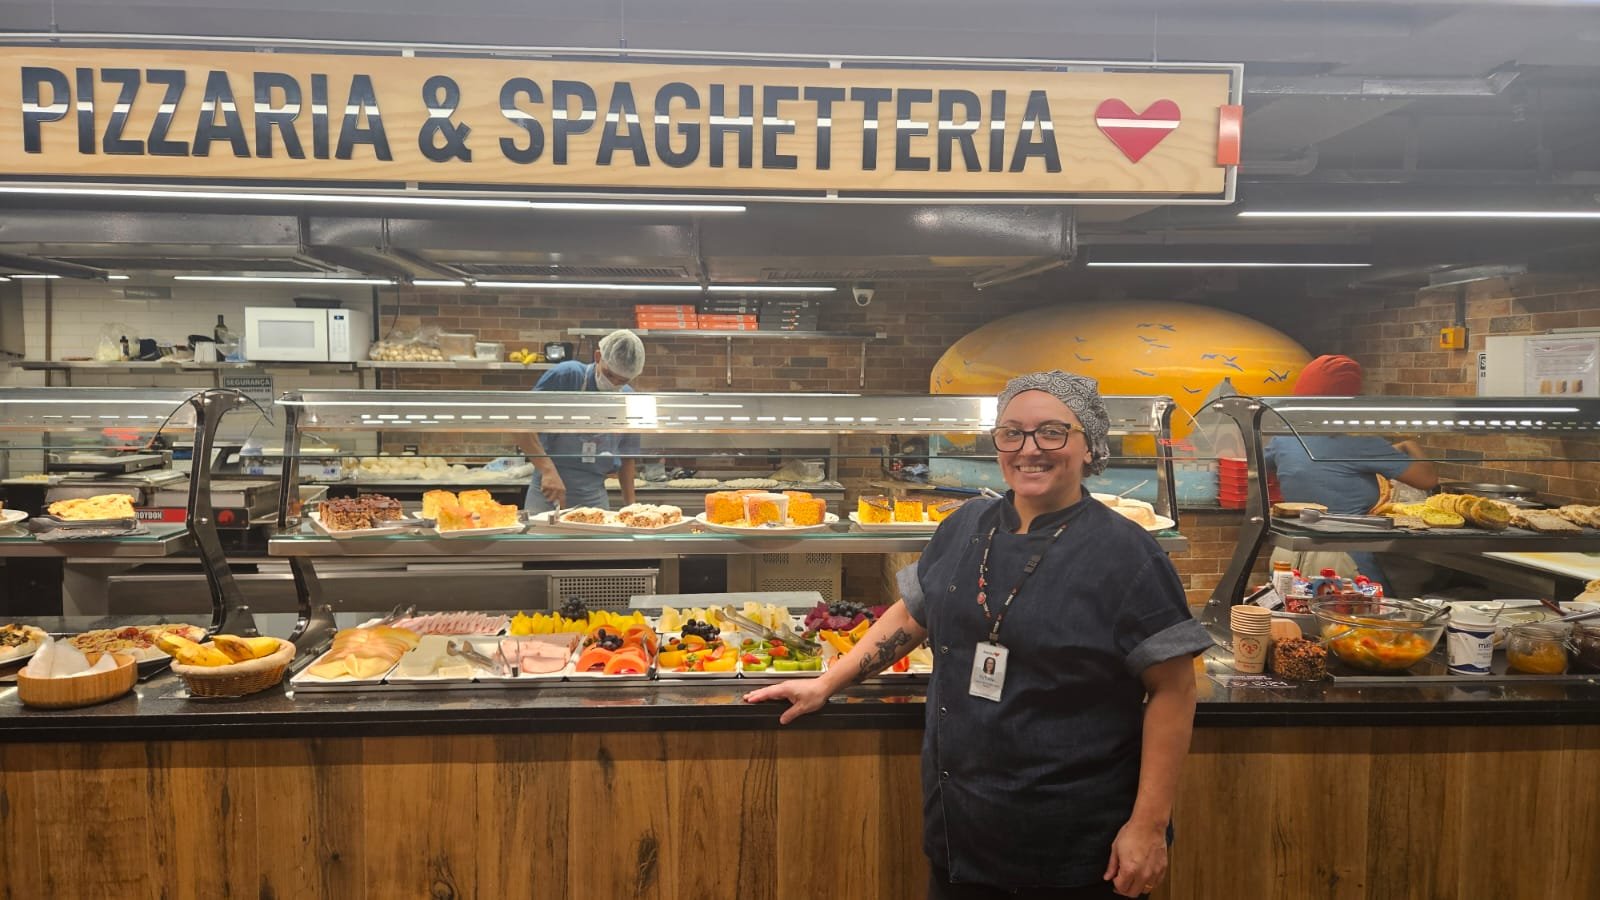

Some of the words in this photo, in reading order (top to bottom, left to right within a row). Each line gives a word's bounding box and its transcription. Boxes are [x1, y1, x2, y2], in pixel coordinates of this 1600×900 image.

[21, 66, 393, 162] PIZZARIA
[418, 75, 472, 163] &
[499, 77, 1062, 174] SPAGHETTERIA
[226, 378, 270, 387] SEGURANÇA
